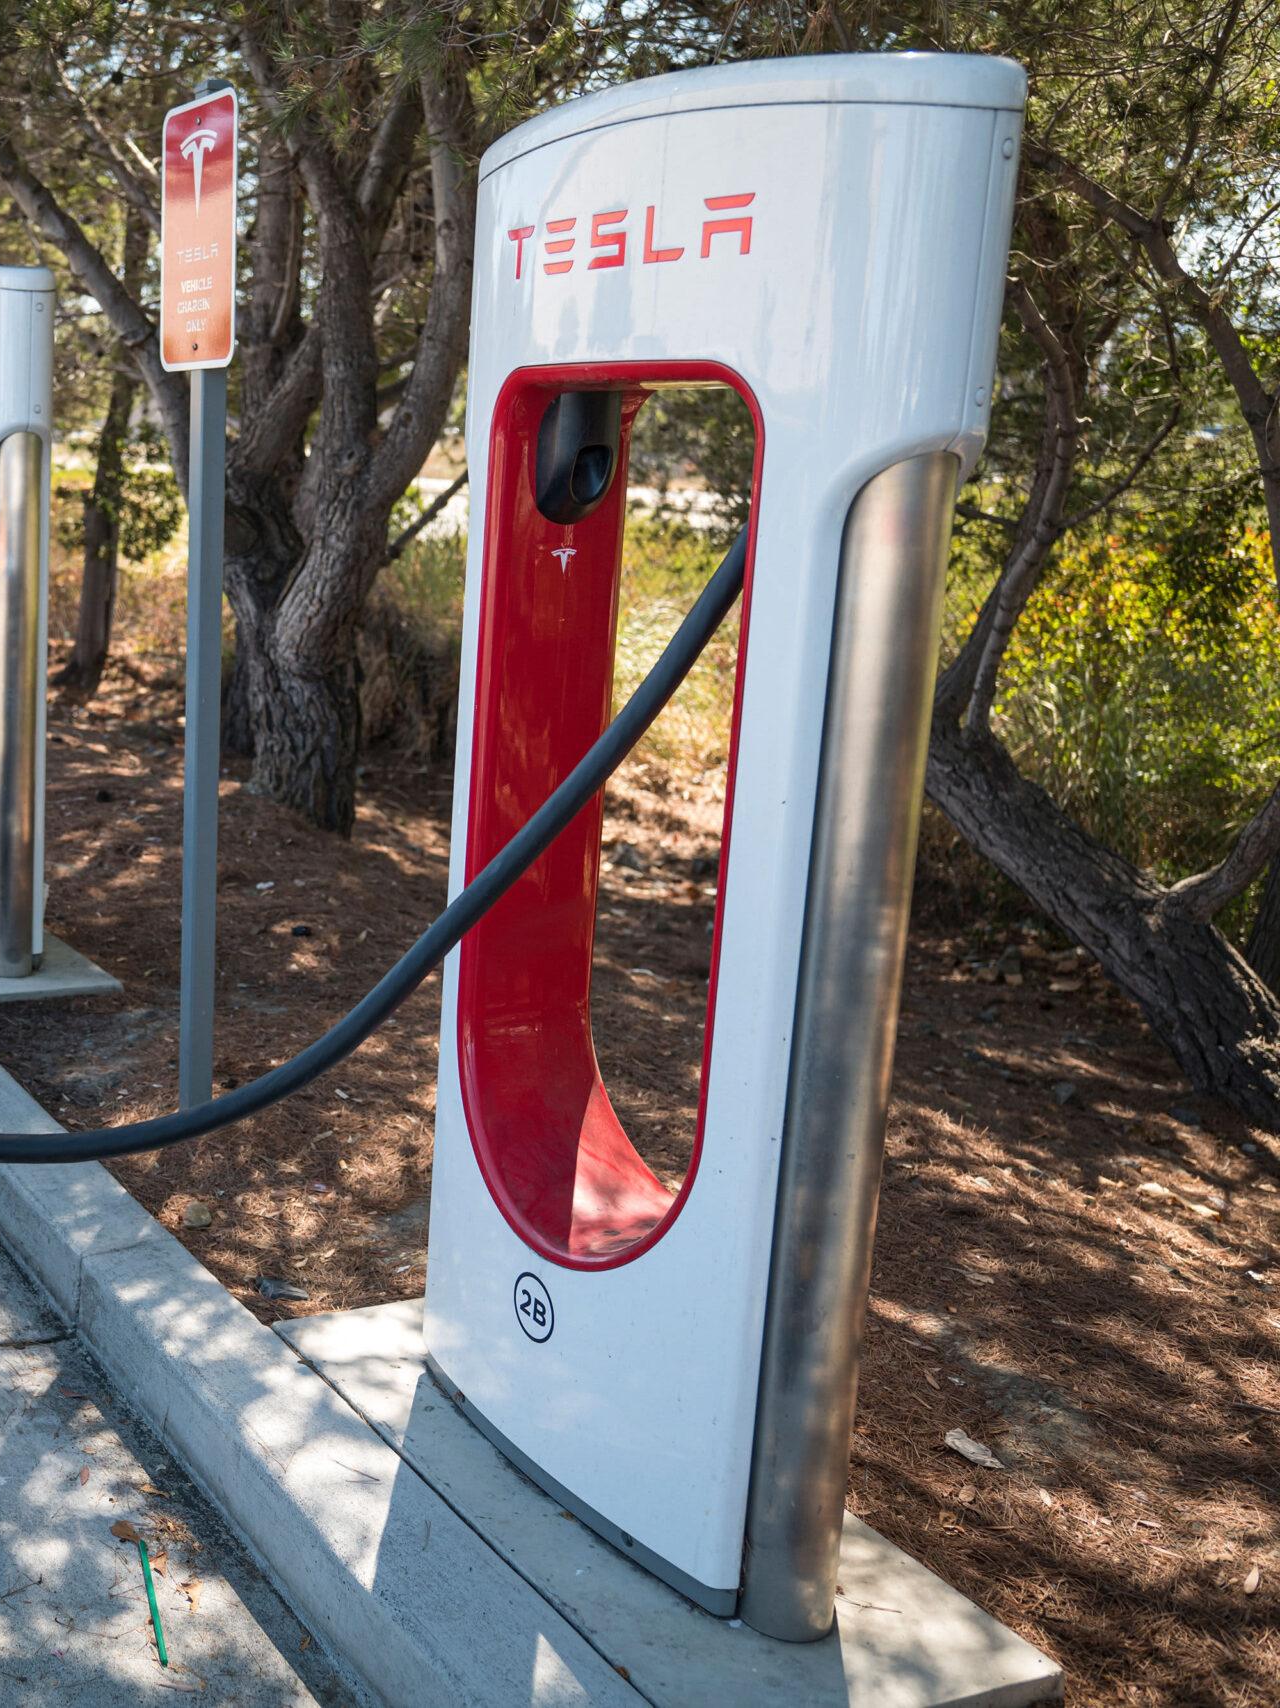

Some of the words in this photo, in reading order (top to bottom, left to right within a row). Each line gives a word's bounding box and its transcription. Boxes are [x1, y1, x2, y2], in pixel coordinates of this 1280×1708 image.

[507, 192, 756, 280] TESLA
[176, 242, 219, 265] TESLA
[180, 276, 213, 294] VEHICLE
[520, 1289, 546, 1327] 2B
